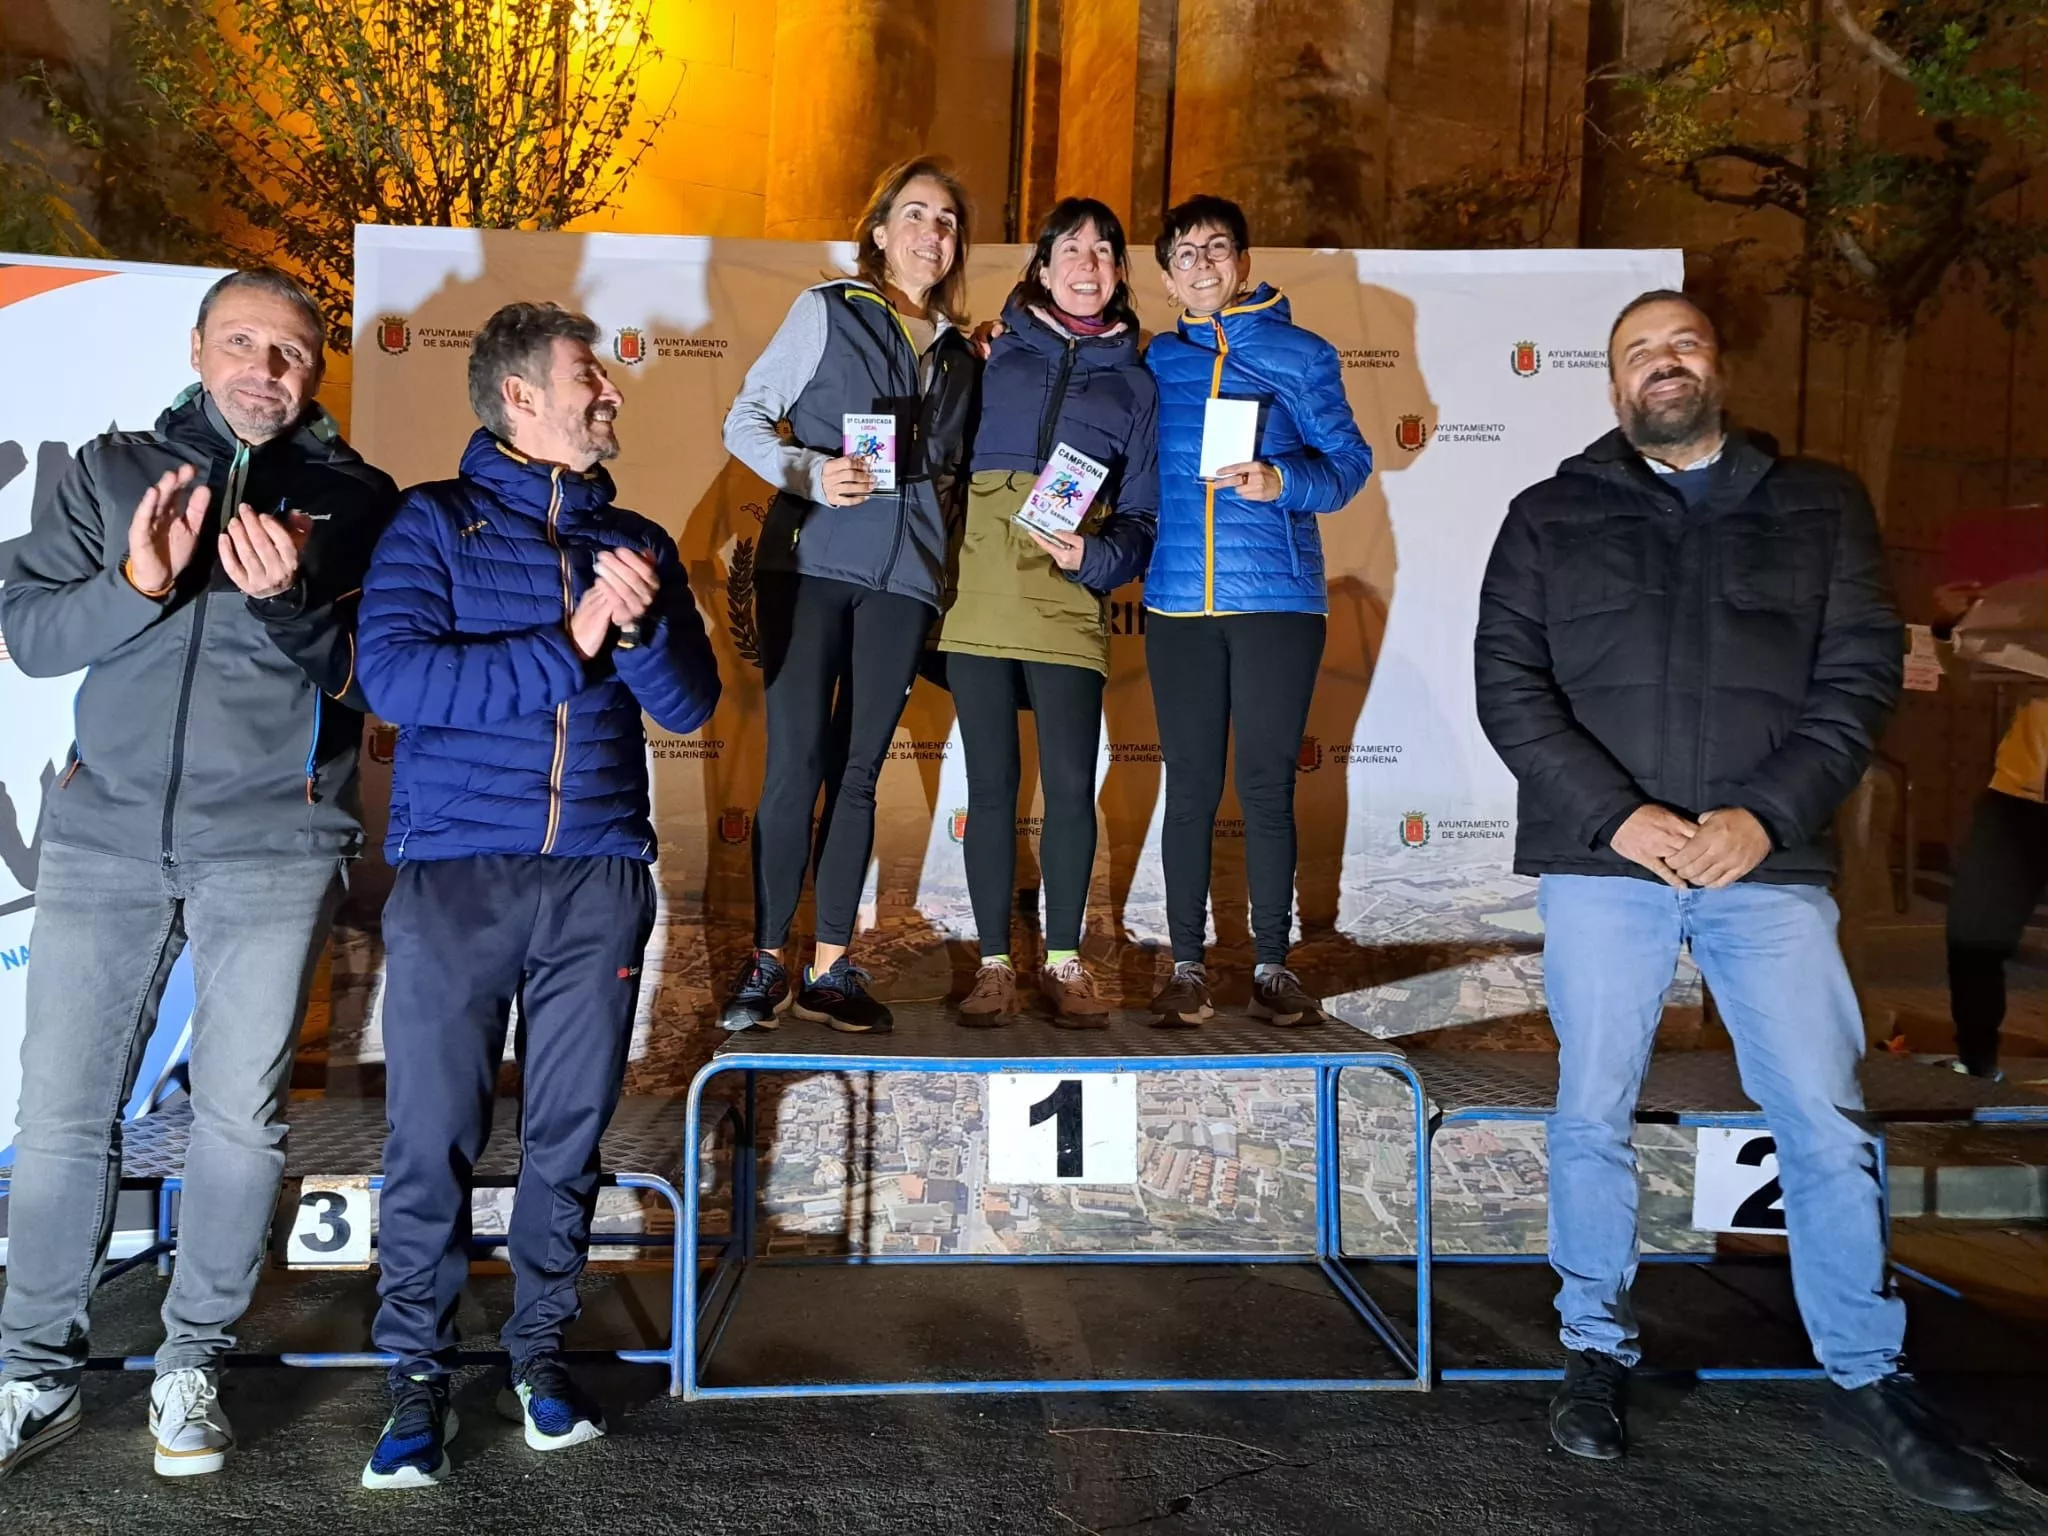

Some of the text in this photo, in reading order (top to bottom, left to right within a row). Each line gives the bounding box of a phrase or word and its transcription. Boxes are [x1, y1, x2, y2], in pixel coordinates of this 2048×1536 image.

[418, 328, 475, 338] AYUNTAMIE
[423, 338, 470, 348] DE SARIÑ
[653, 337, 728, 348] AYUNTAMIENTO
[657, 348, 723, 358] DE SARIÑENA
[1338, 350, 1400, 358] UNTAMIENTO
[1547, 350, 1608, 358] AYUNTAMIEN
[1347, 358, 1396, 368] SARIÑENA
[1552, 360, 1565, 368] DE
[854, 417, 892, 425] CLASIFICADA
[1433, 423, 1506, 432] AYUNTAMIENTO
[1437, 432, 1502, 442] DE SARIÑENA
[1057, 447, 1104, 480] CAMPEONA
[1065, 463, 1086, 478] LOCAL
[648, 740, 725, 748] AYUNTAMIENTO
[892, 741, 953, 750] UNTAMIENTO
[1104, 744, 1161, 752] AYUNTAMIEN
[1329, 744, 1403, 753] AYUNTAMIENTO
[652, 749, 720, 758] DE SARIÑENA
[900, 750, 948, 760] SARIÑENA
[1123, 752, 1163, 762] SARIÑEN
[1334, 753, 1398, 763] DE SARIÑENA
[1437, 820, 1510, 829] AYUNTAMIENTO
[1457, 829, 1505, 839] SARIÑENA
[1029, 1079, 1083, 1178] 1
[1731, 1135, 1787, 1229] 2
[299, 1190, 351, 1253] 3
